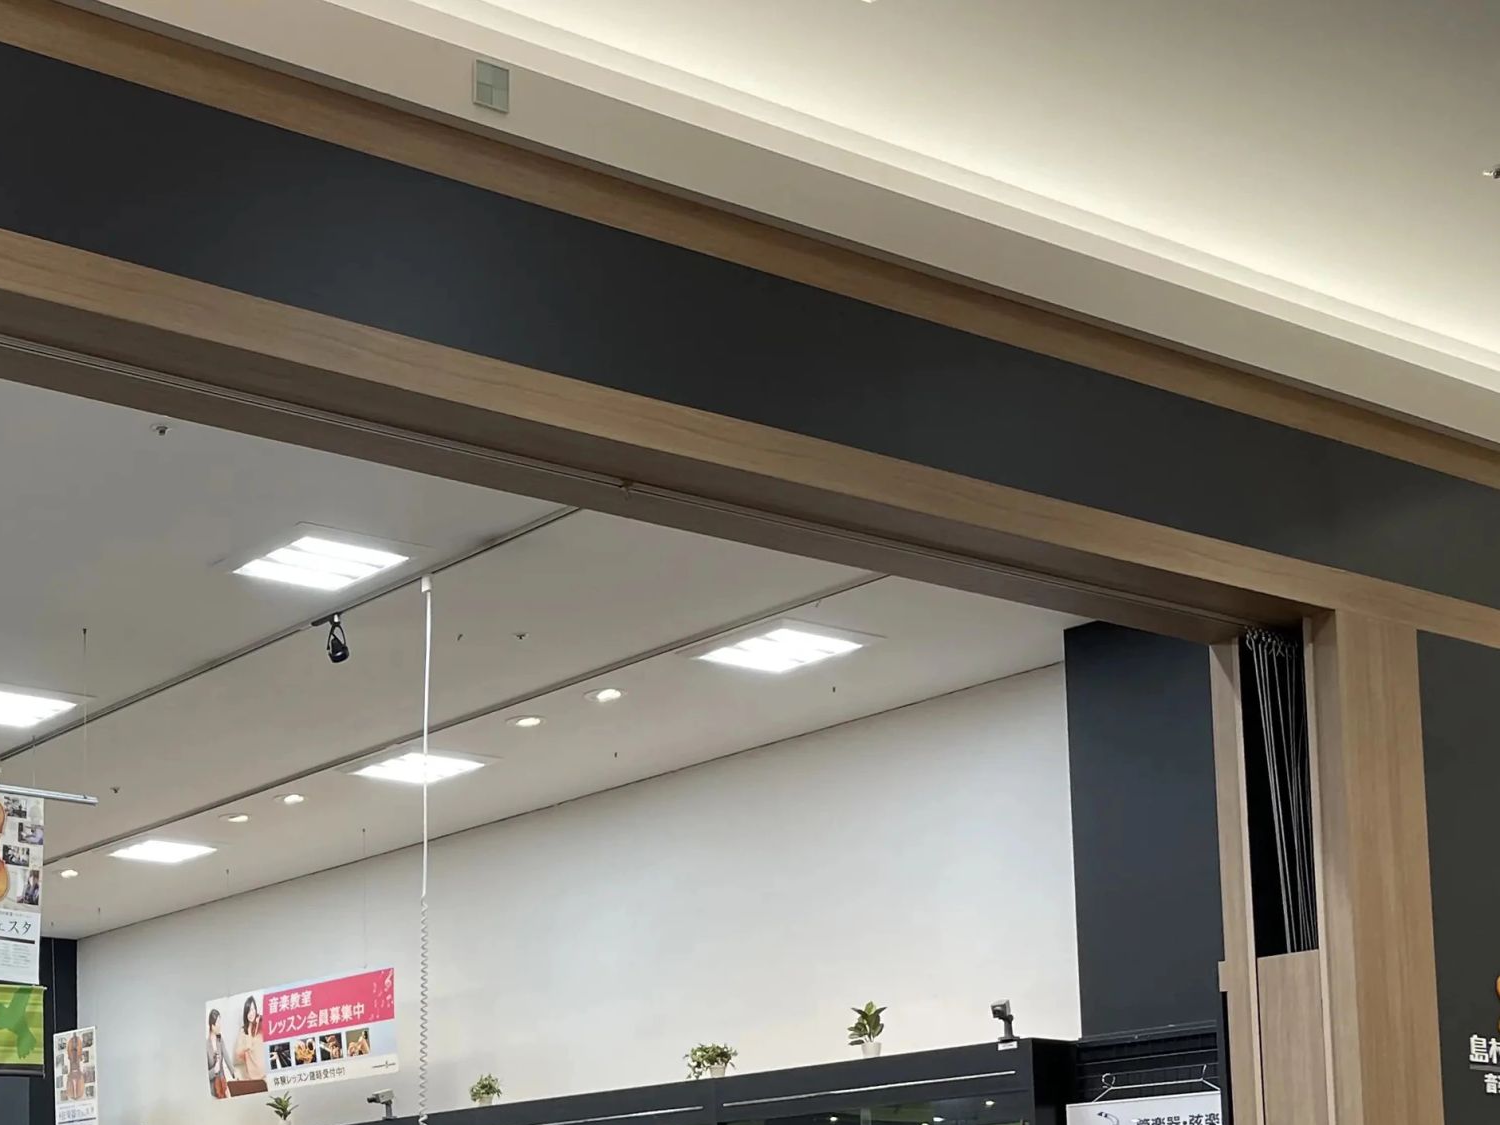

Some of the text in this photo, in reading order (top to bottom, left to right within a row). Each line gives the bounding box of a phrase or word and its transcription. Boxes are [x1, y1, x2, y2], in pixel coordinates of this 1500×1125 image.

[268, 990, 313, 1014] 音楽教室
[268, 1003, 365, 1036] レッスン会員募集中
[1484, 1073, 1500, 1094] 音
